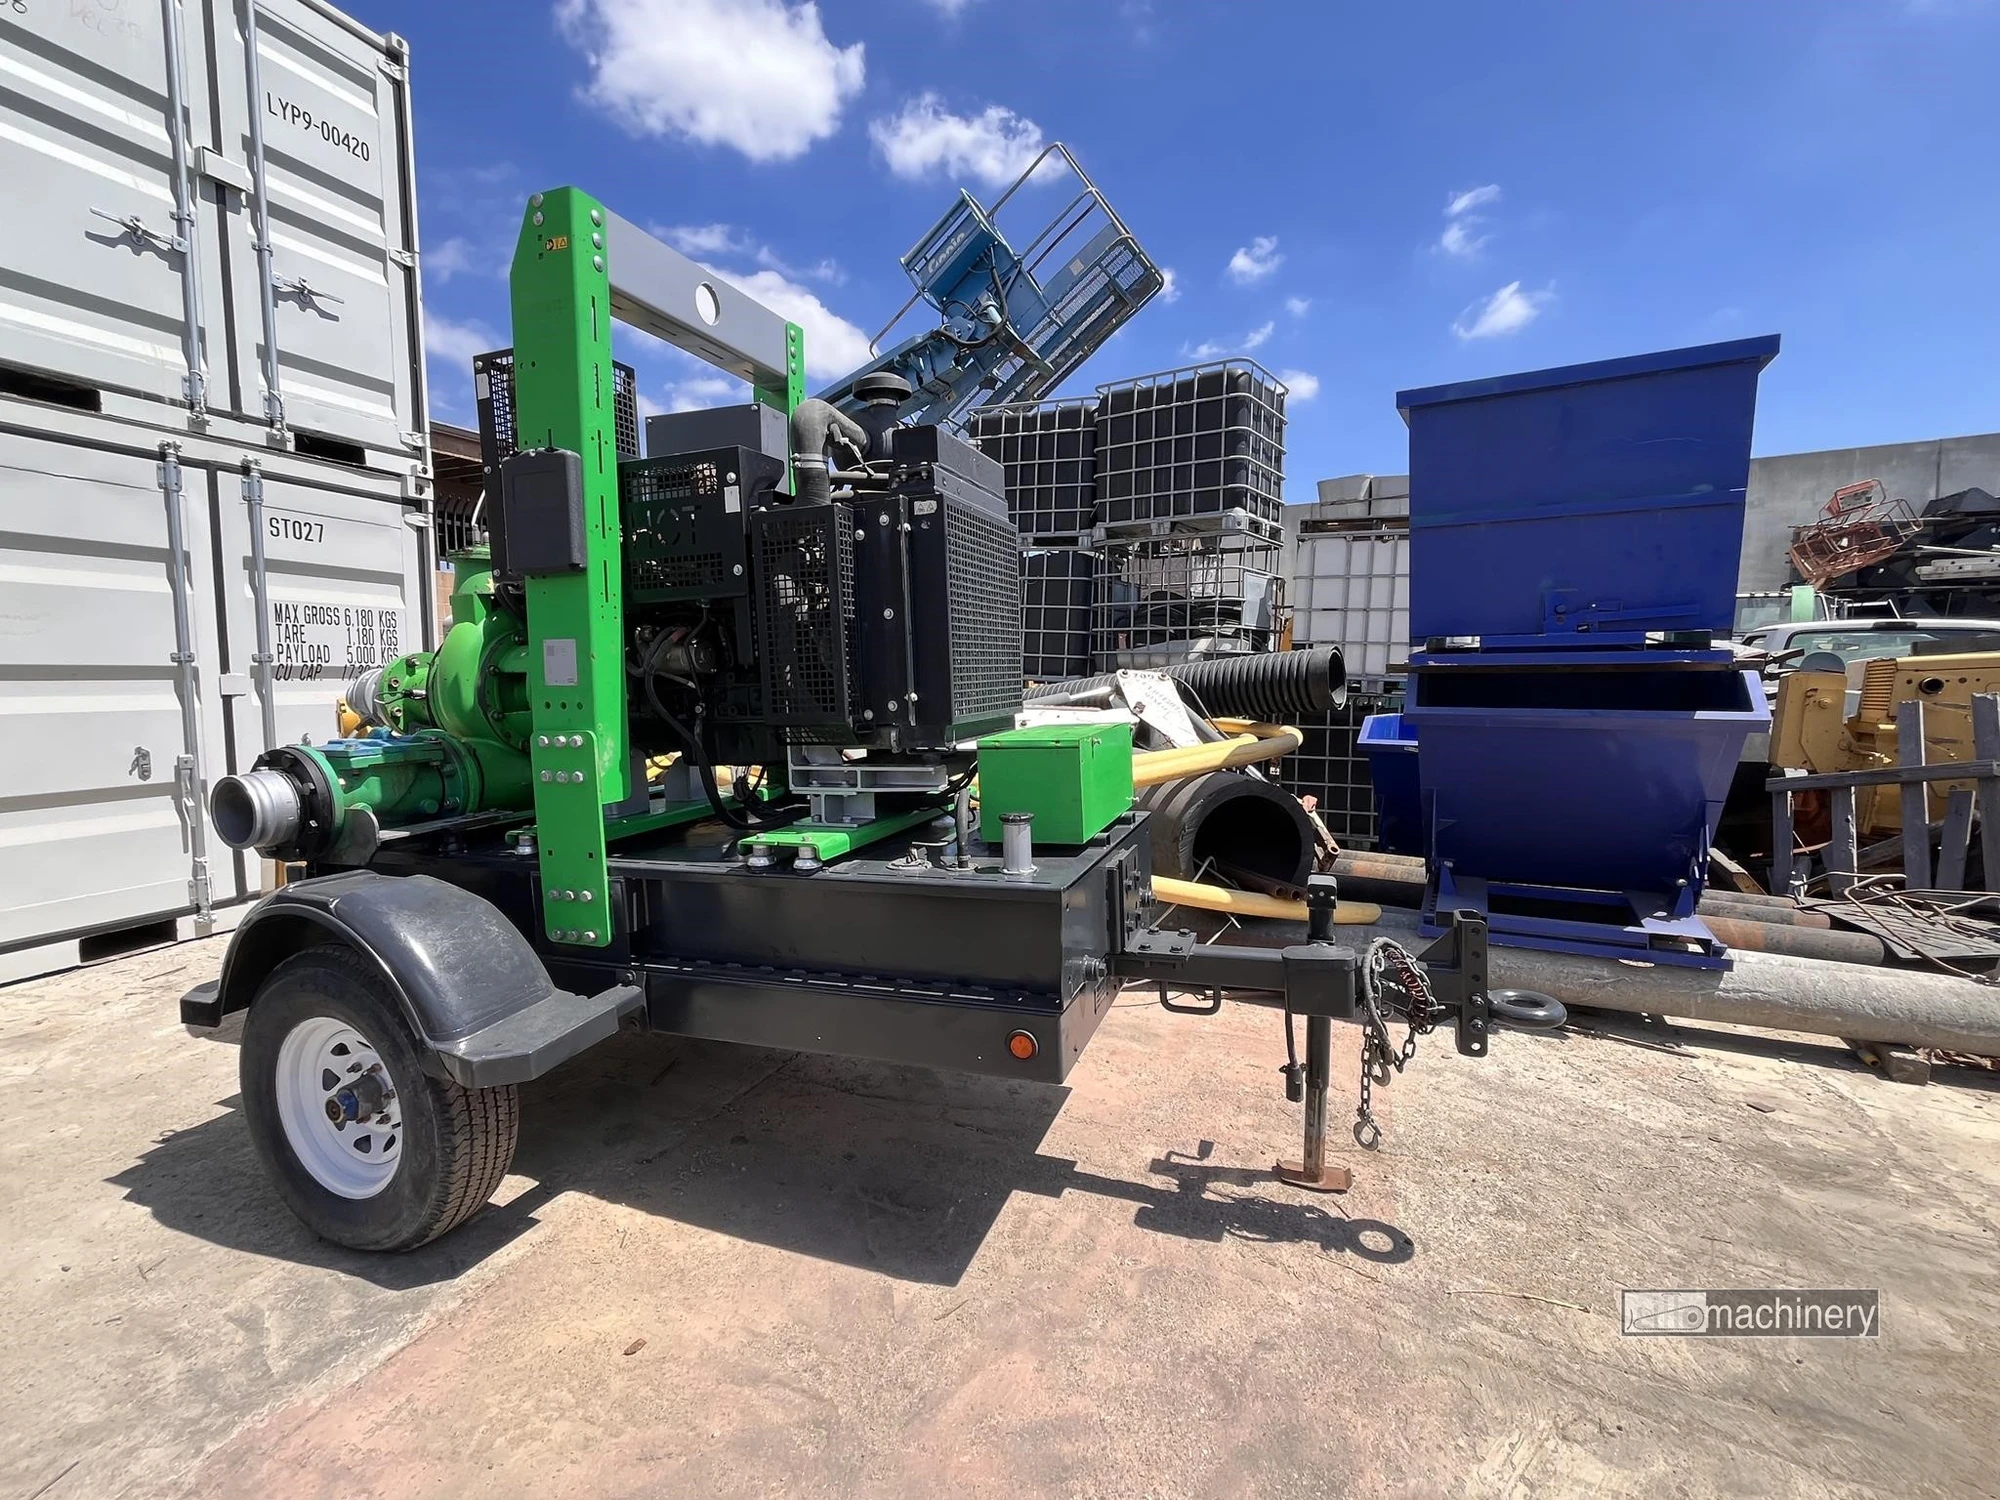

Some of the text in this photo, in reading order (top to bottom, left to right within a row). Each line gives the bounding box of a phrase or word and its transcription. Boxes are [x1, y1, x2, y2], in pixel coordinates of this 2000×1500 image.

[266, 91, 370, 162] LYP9-00420
[274, 602, 398, 629] MAX GROSS 6.180 KGS
[275, 623, 399, 647] TARE 1.180 KGS
[276, 643, 331, 663] PAYLOAD
[346, 645, 376, 664] 5.000
